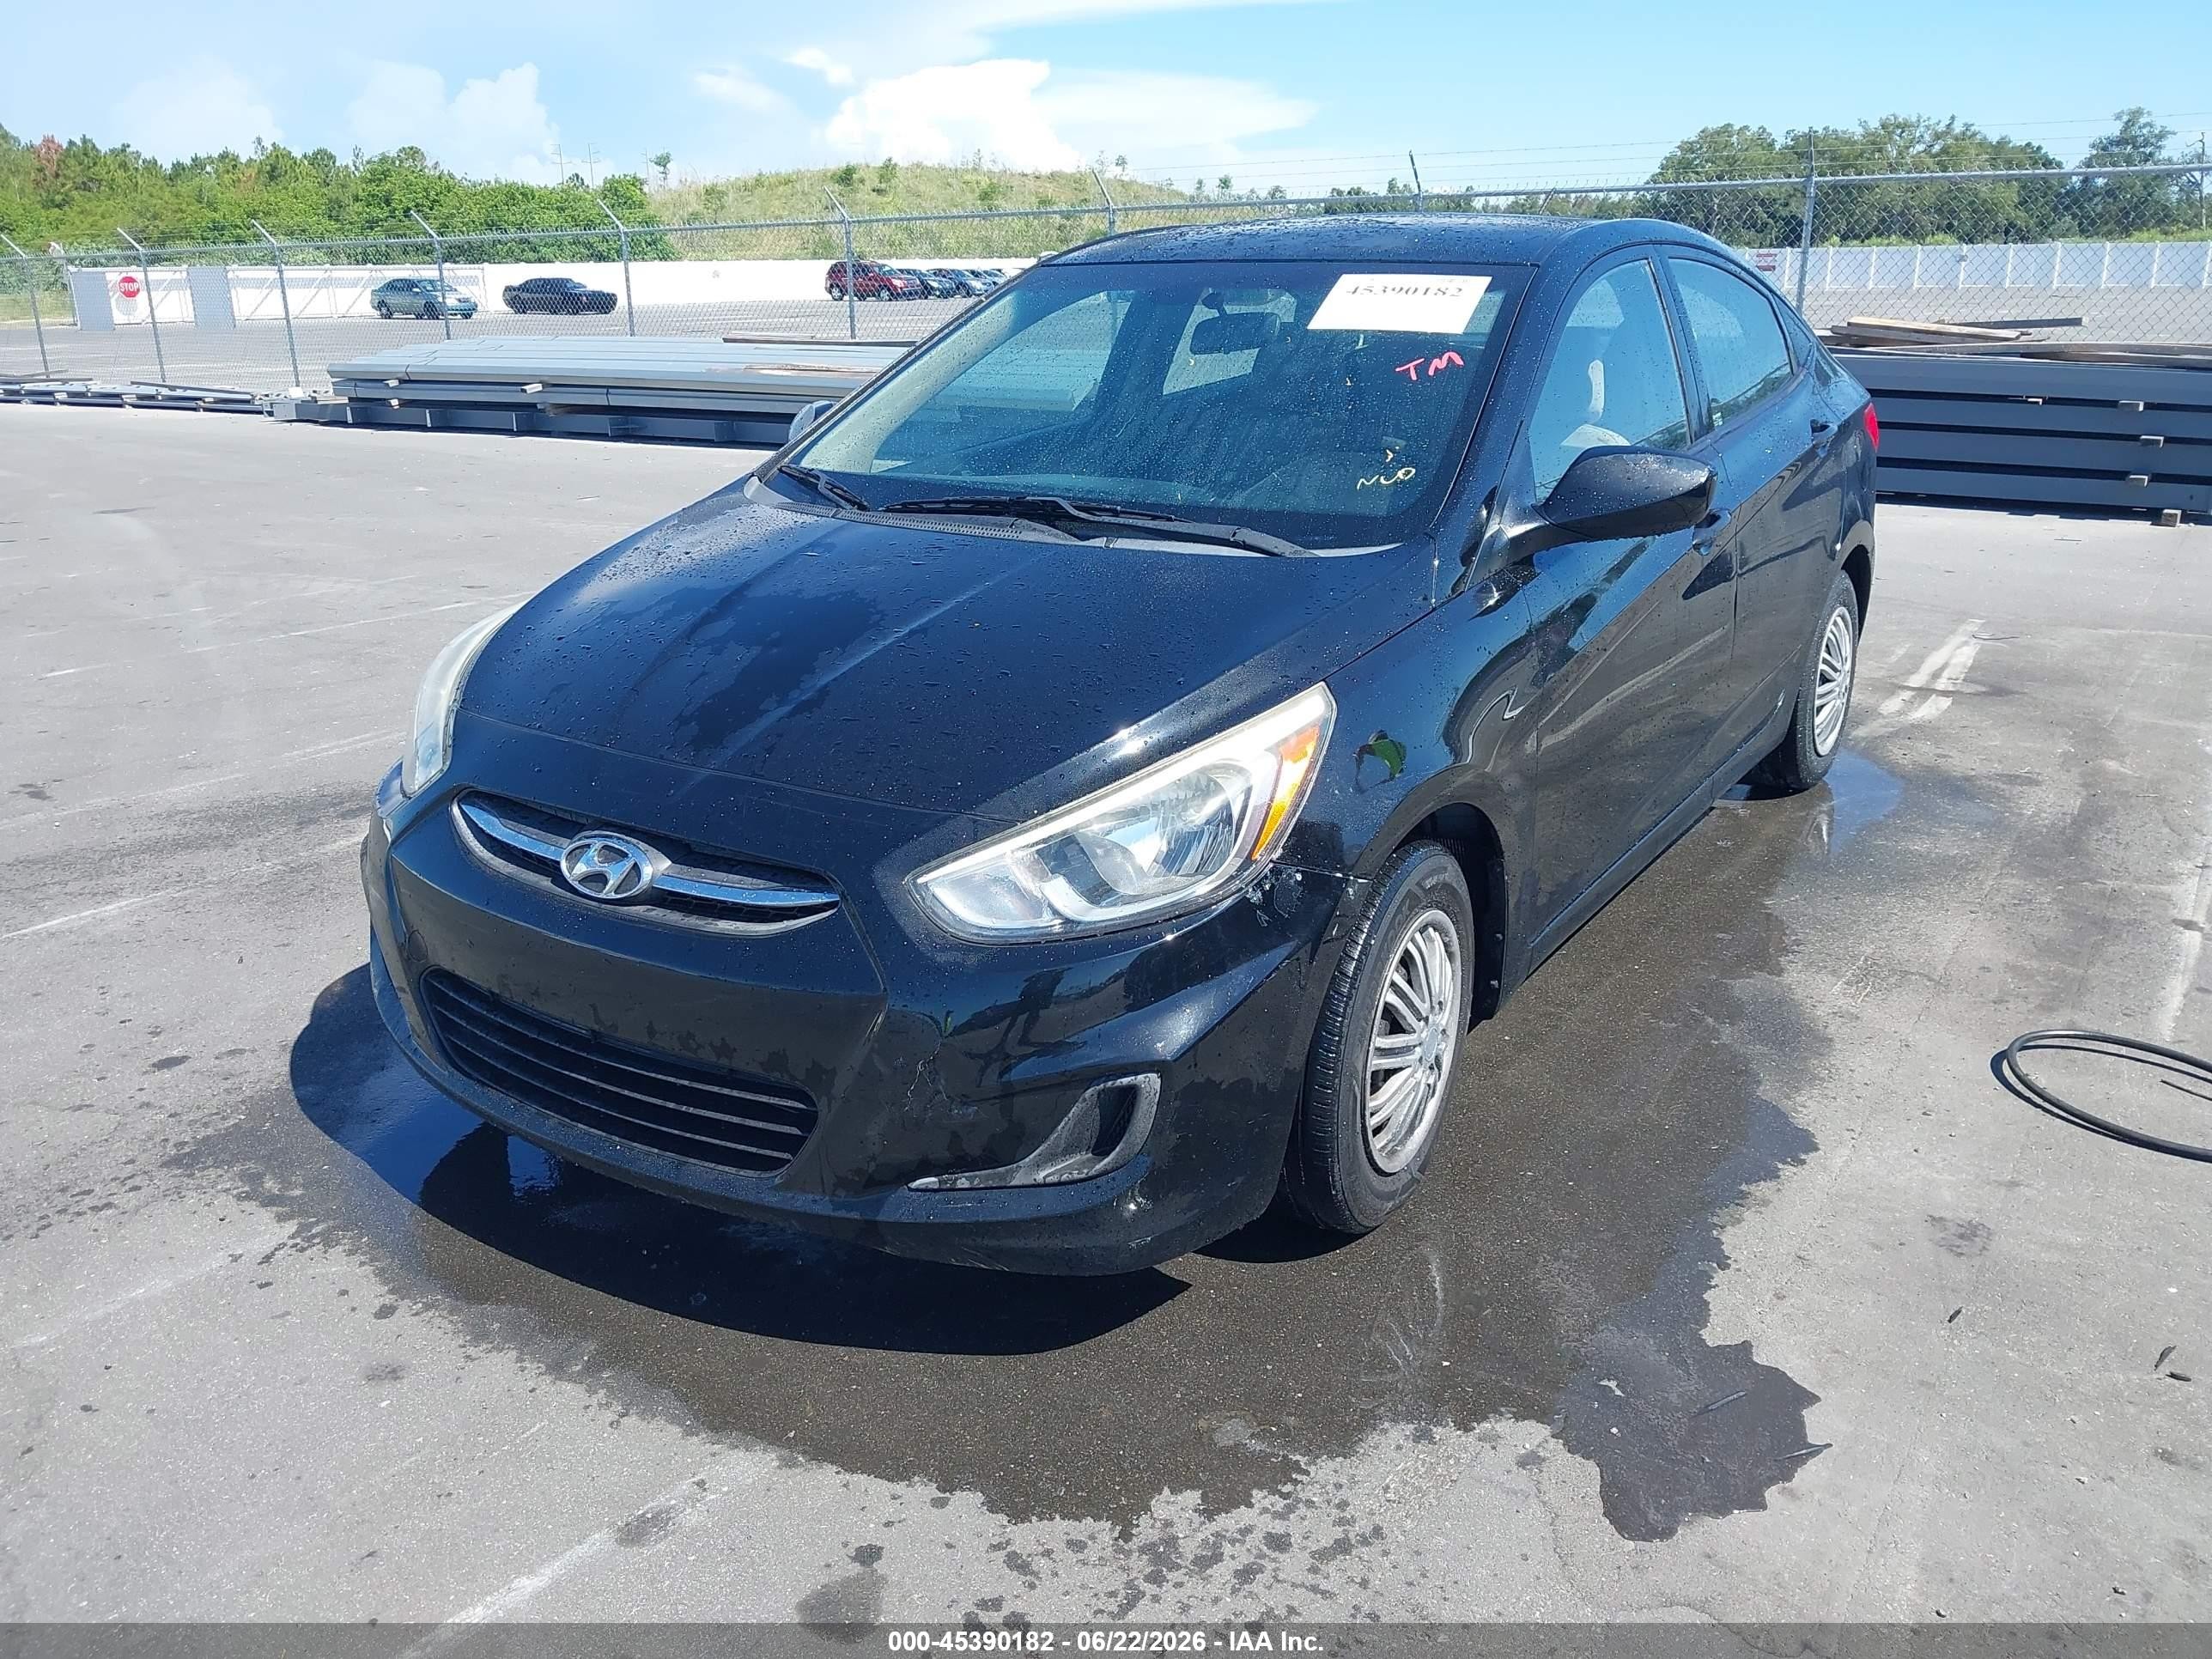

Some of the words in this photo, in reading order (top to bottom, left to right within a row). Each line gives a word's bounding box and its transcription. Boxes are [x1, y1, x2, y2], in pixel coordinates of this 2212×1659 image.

[119, 282, 139, 292] STOP
[1346, 285, 1463, 297] 45390182
[1395, 350, 1465, 381] TM
